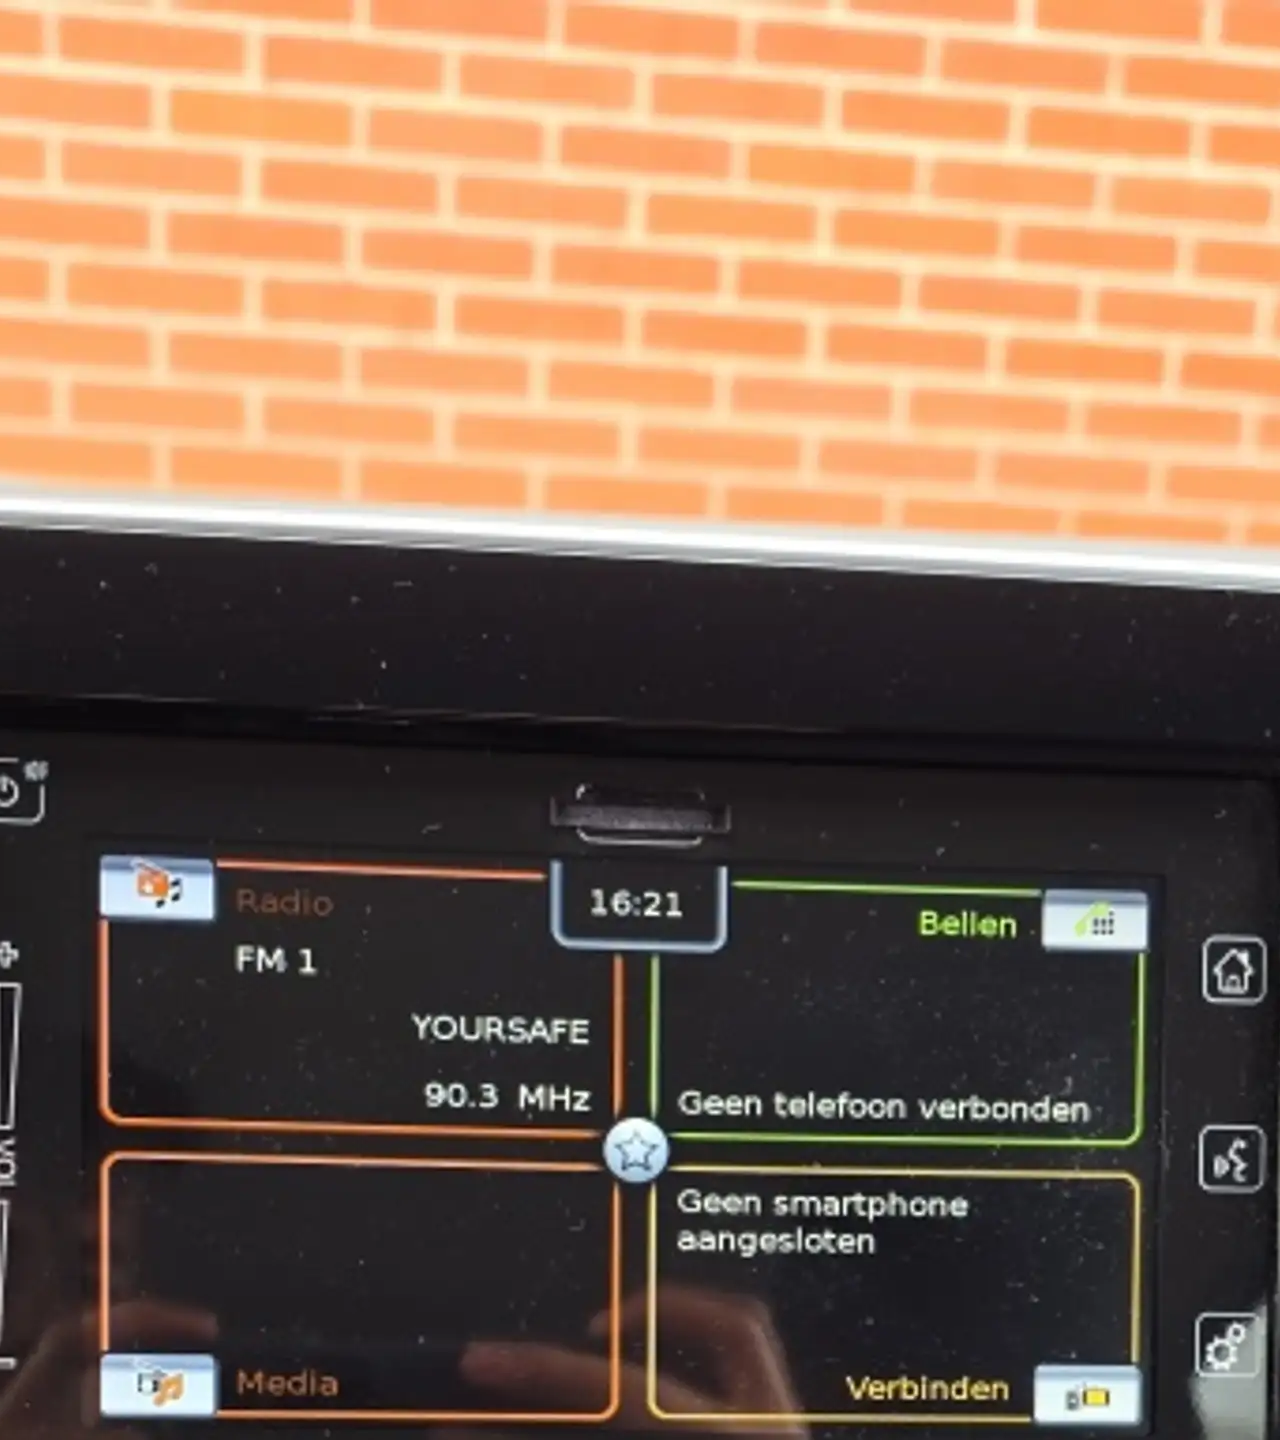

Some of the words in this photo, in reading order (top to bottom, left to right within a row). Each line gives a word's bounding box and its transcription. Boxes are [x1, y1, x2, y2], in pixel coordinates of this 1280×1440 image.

[235, 887, 335, 918] Radio
[590, 888, 684, 919] 16:21
[919, 908, 1018, 939] Bellen
[235, 945, 287, 974] FM
[299, 947, 318, 975] 1
[411, 1013, 590, 1046] YOURSAFE
[423, 1081, 499, 1110] 90.3
[518, 1083, 592, 1112] MHz
[677, 1089, 762, 1117] Geen
[773, 1090, 906, 1120] telefoon
[918, 1094, 1090, 1124] verbonden
[677, 1187, 762, 1216] Geen
[773, 1190, 969, 1225] smartphone
[676, 1225, 876, 1258] aangesloten
[236, 1368, 339, 1397] Media
[845, 1374, 1010, 1402] Verbinden
